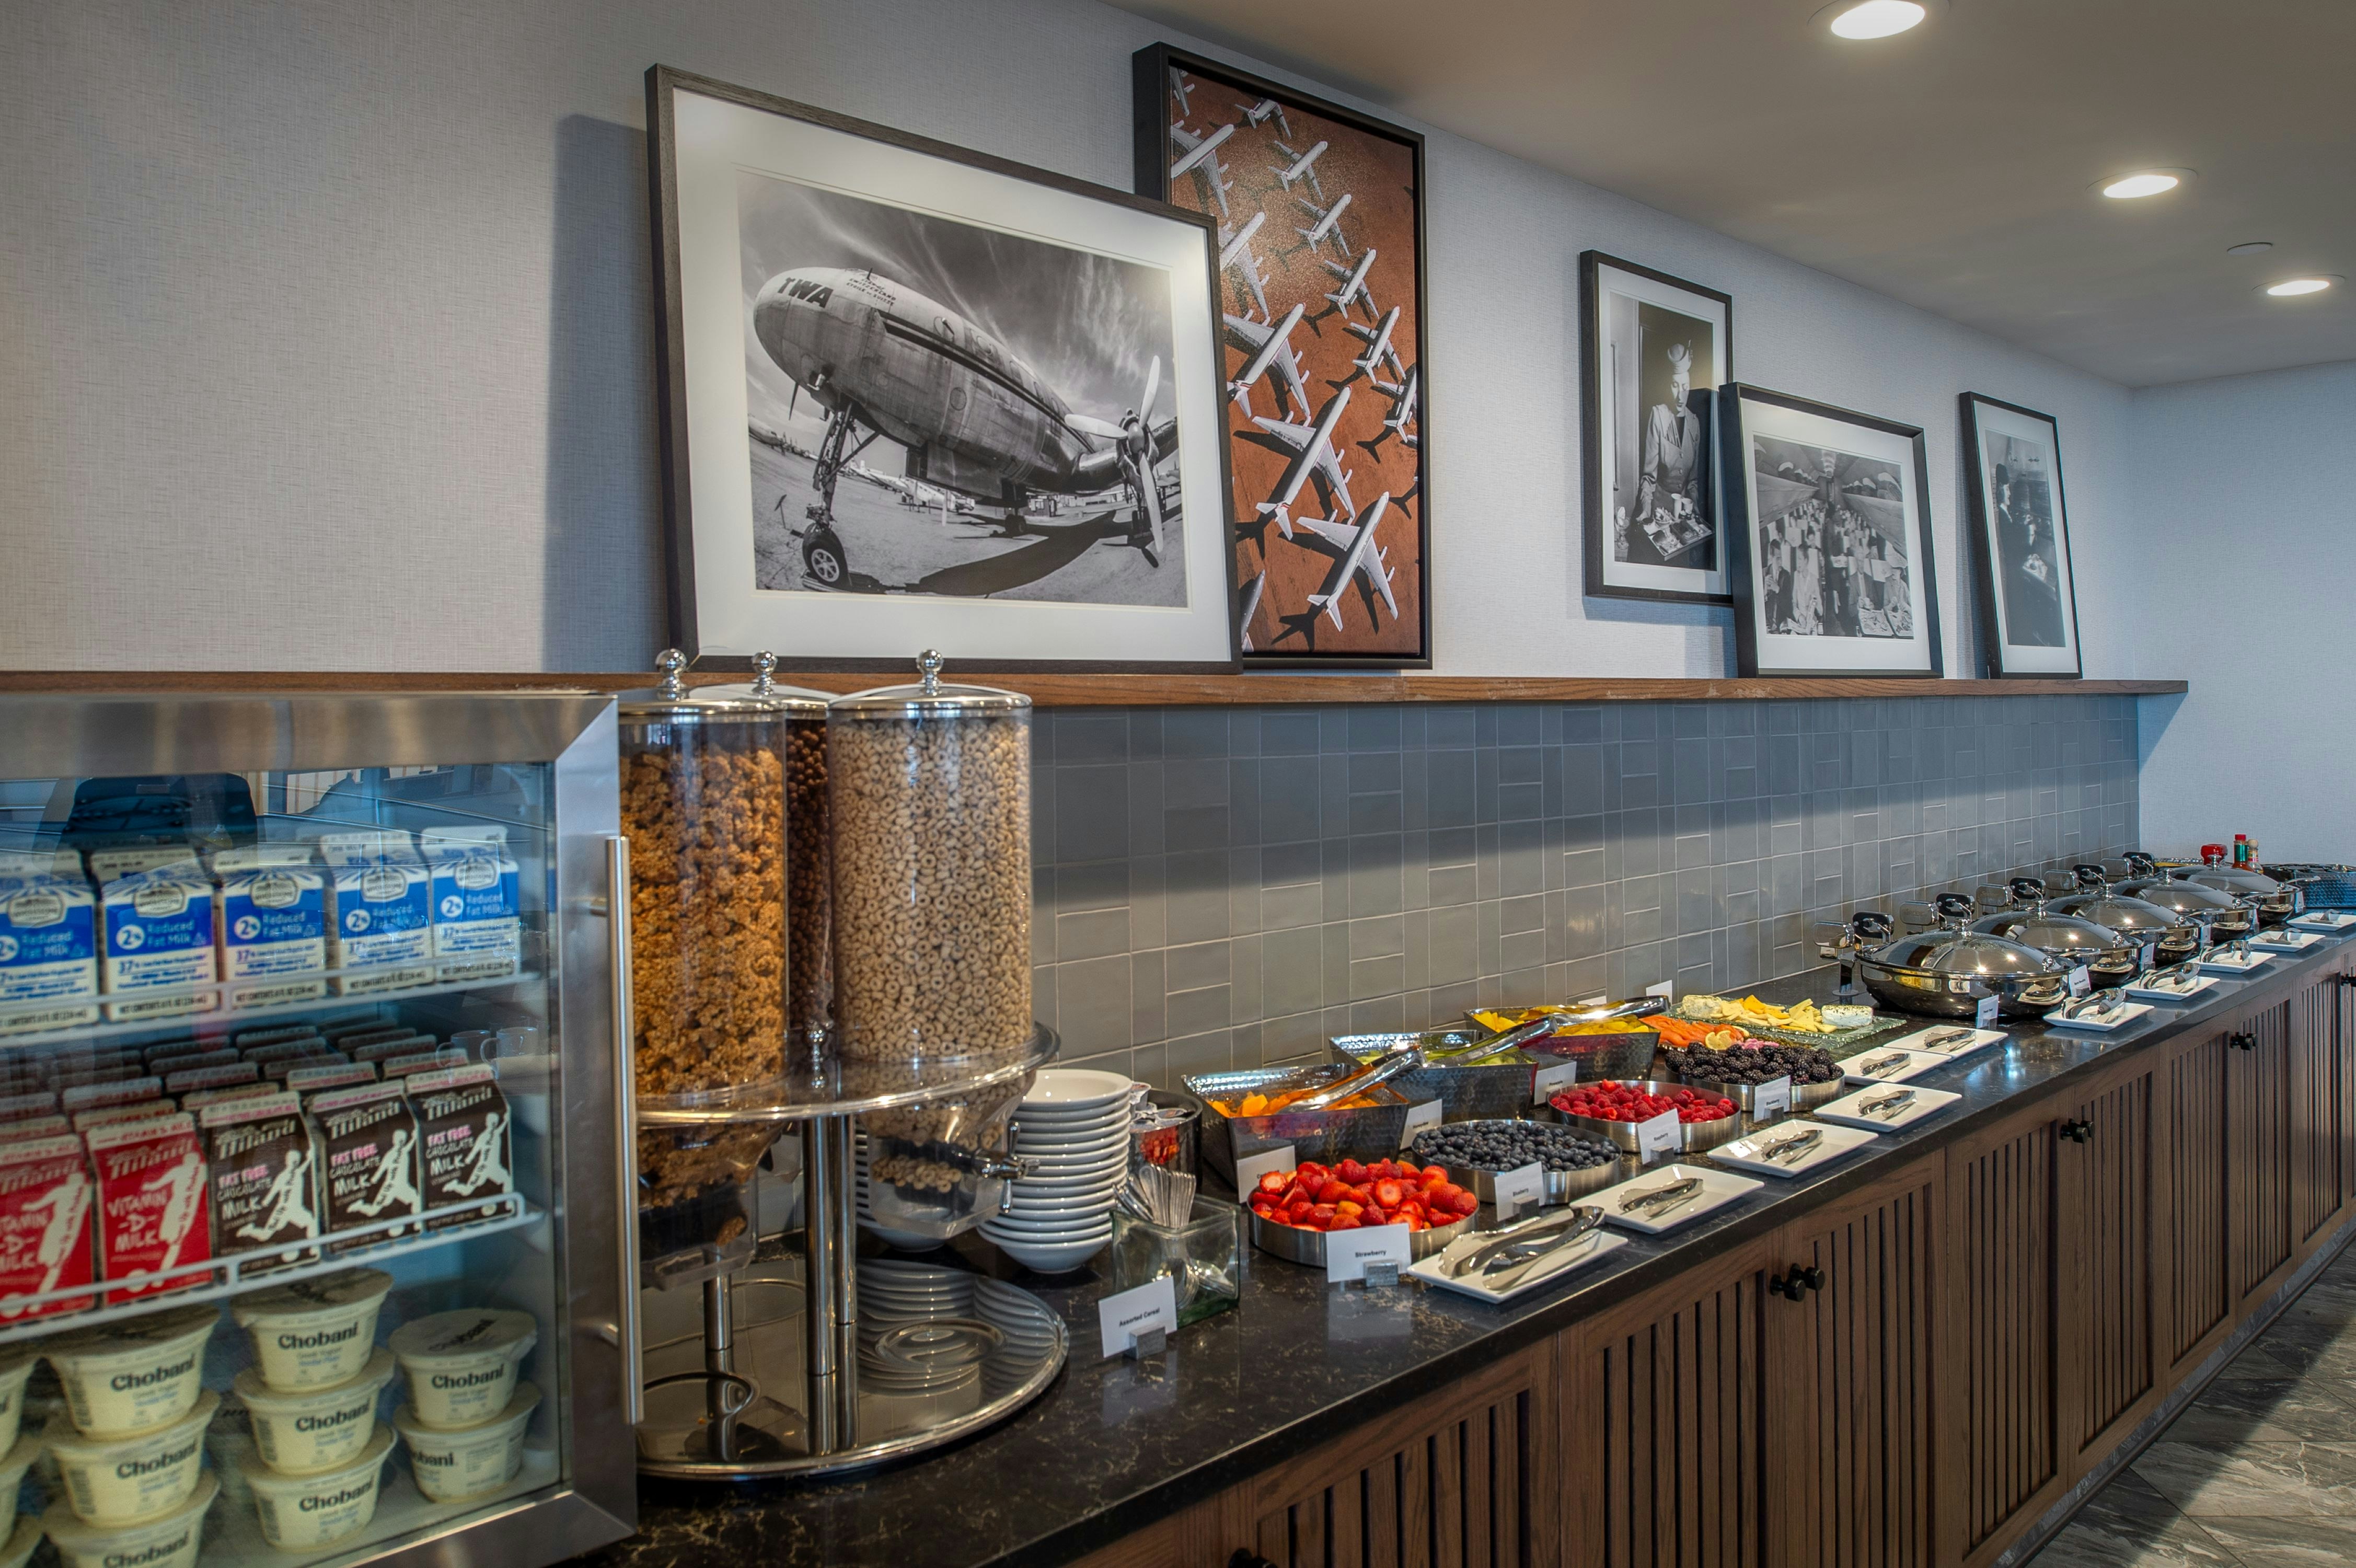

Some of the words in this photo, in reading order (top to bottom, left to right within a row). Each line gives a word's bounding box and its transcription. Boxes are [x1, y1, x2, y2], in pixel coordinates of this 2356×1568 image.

[778, 277, 834, 308] TWA
[466, 893, 502, 904] Reduced
[147, 919, 195, 933] Reduced
[262, 910, 306, 923] Reduced
[22, 931, 73, 945] Reduced
[425, 1136, 475, 1159] CHOCOLATE
[426, 1132, 446, 1146] FAT
[447, 1124, 472, 1143] FREE
[329, 1155, 382, 1180] CHOCOLATE
[330, 1151, 351, 1168] FAT
[352, 1142, 378, 1161] FREE
[430, 1153, 467, 1177] MILK
[217, 1177, 272, 1202] CHOCOLATE
[218, 1172, 240, 1190] FAT
[241, 1164, 269, 1183] FREE
[333, 1173, 372, 1197] MILK
[107, 1188, 168, 1218] VITAMIN
[222, 1195, 263, 1220] MILK
[114, 1229, 159, 1253] MILK
[1355, 1250, 1387, 1258] Strawberry
[1119, 1312, 1143, 1328] Assorted
[1144, 1307, 1160, 1318] Cereal
[278, 1321, 358, 1350] Chobani
[111, 1353, 195, 1392] Chobani
[431, 1363, 504, 1389] Chobani
[295, 1397, 371, 1433] Chobani
[117, 1438, 198, 1479] Chobani
[299, 1475, 374, 1512] Chobani
[103, 1529, 189, 1568] Chobani
